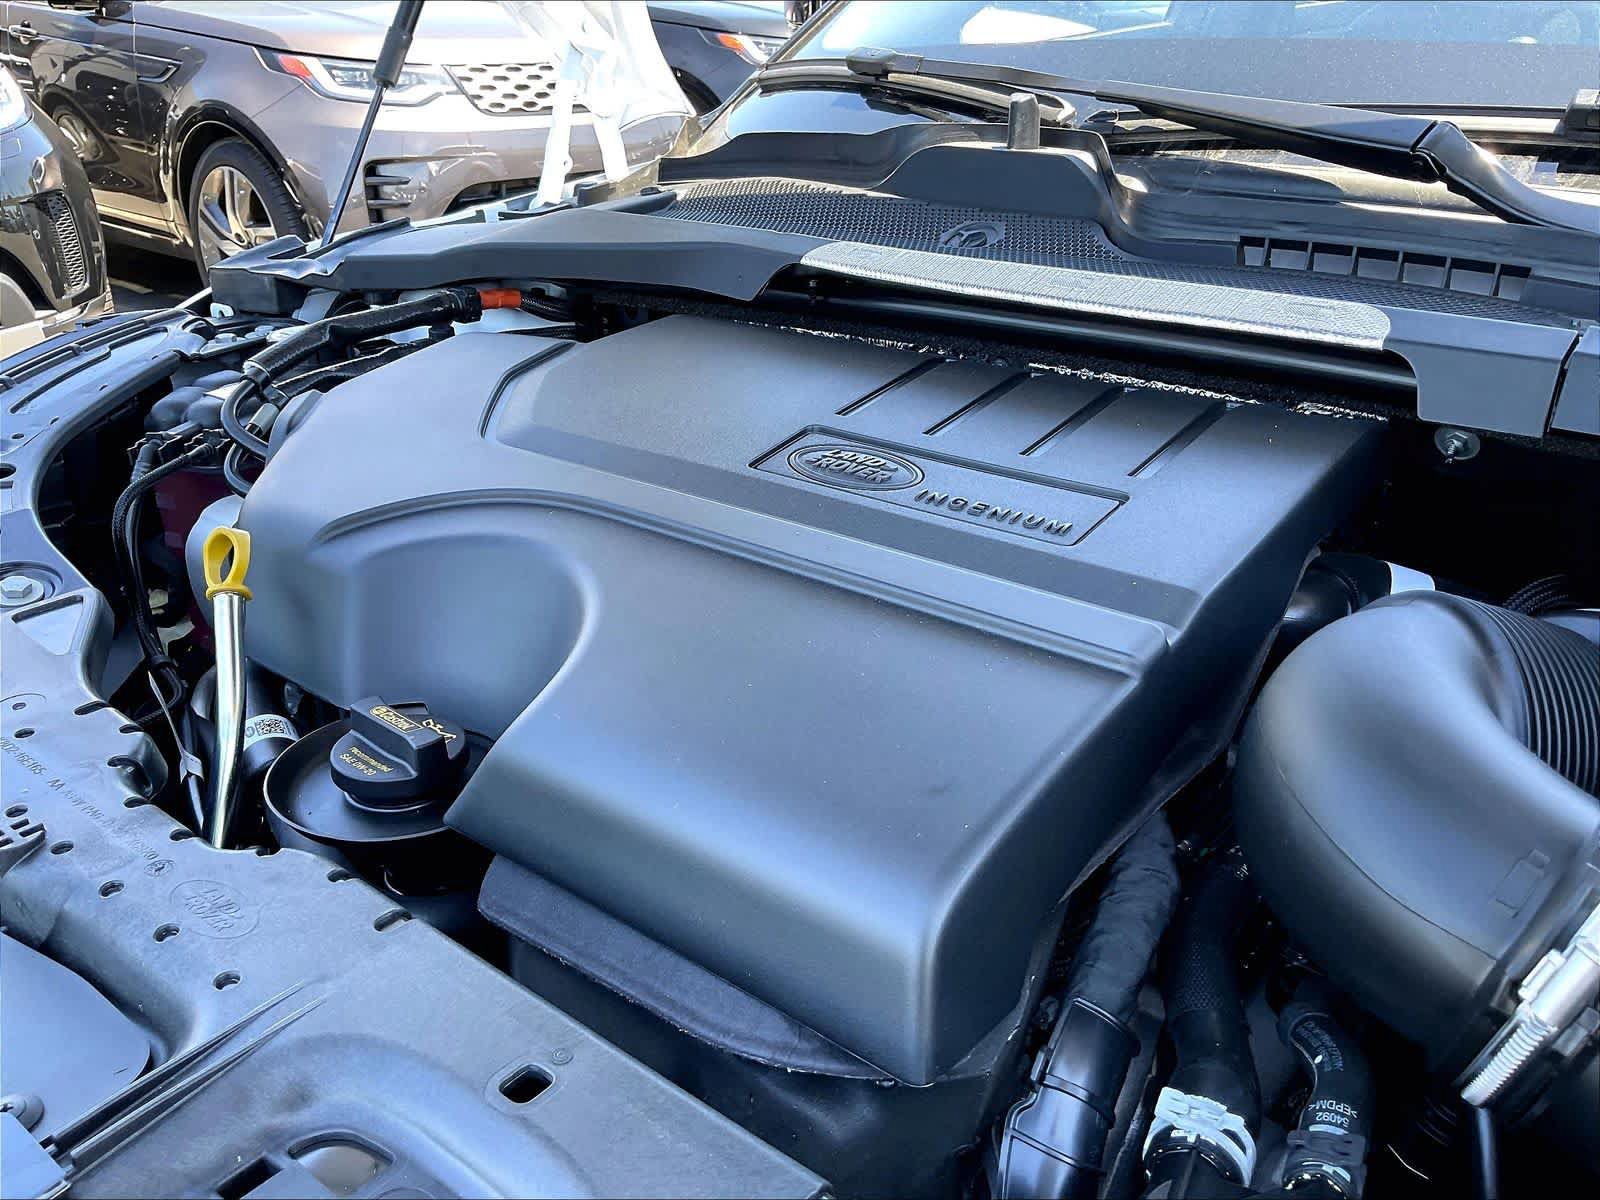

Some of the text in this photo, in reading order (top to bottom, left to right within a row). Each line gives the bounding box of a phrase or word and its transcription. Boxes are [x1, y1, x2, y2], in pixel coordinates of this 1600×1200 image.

[811, 457, 893, 484] ROVER
[821, 449, 887, 467] LAND
[914, 489, 1074, 537] INGENIUM
